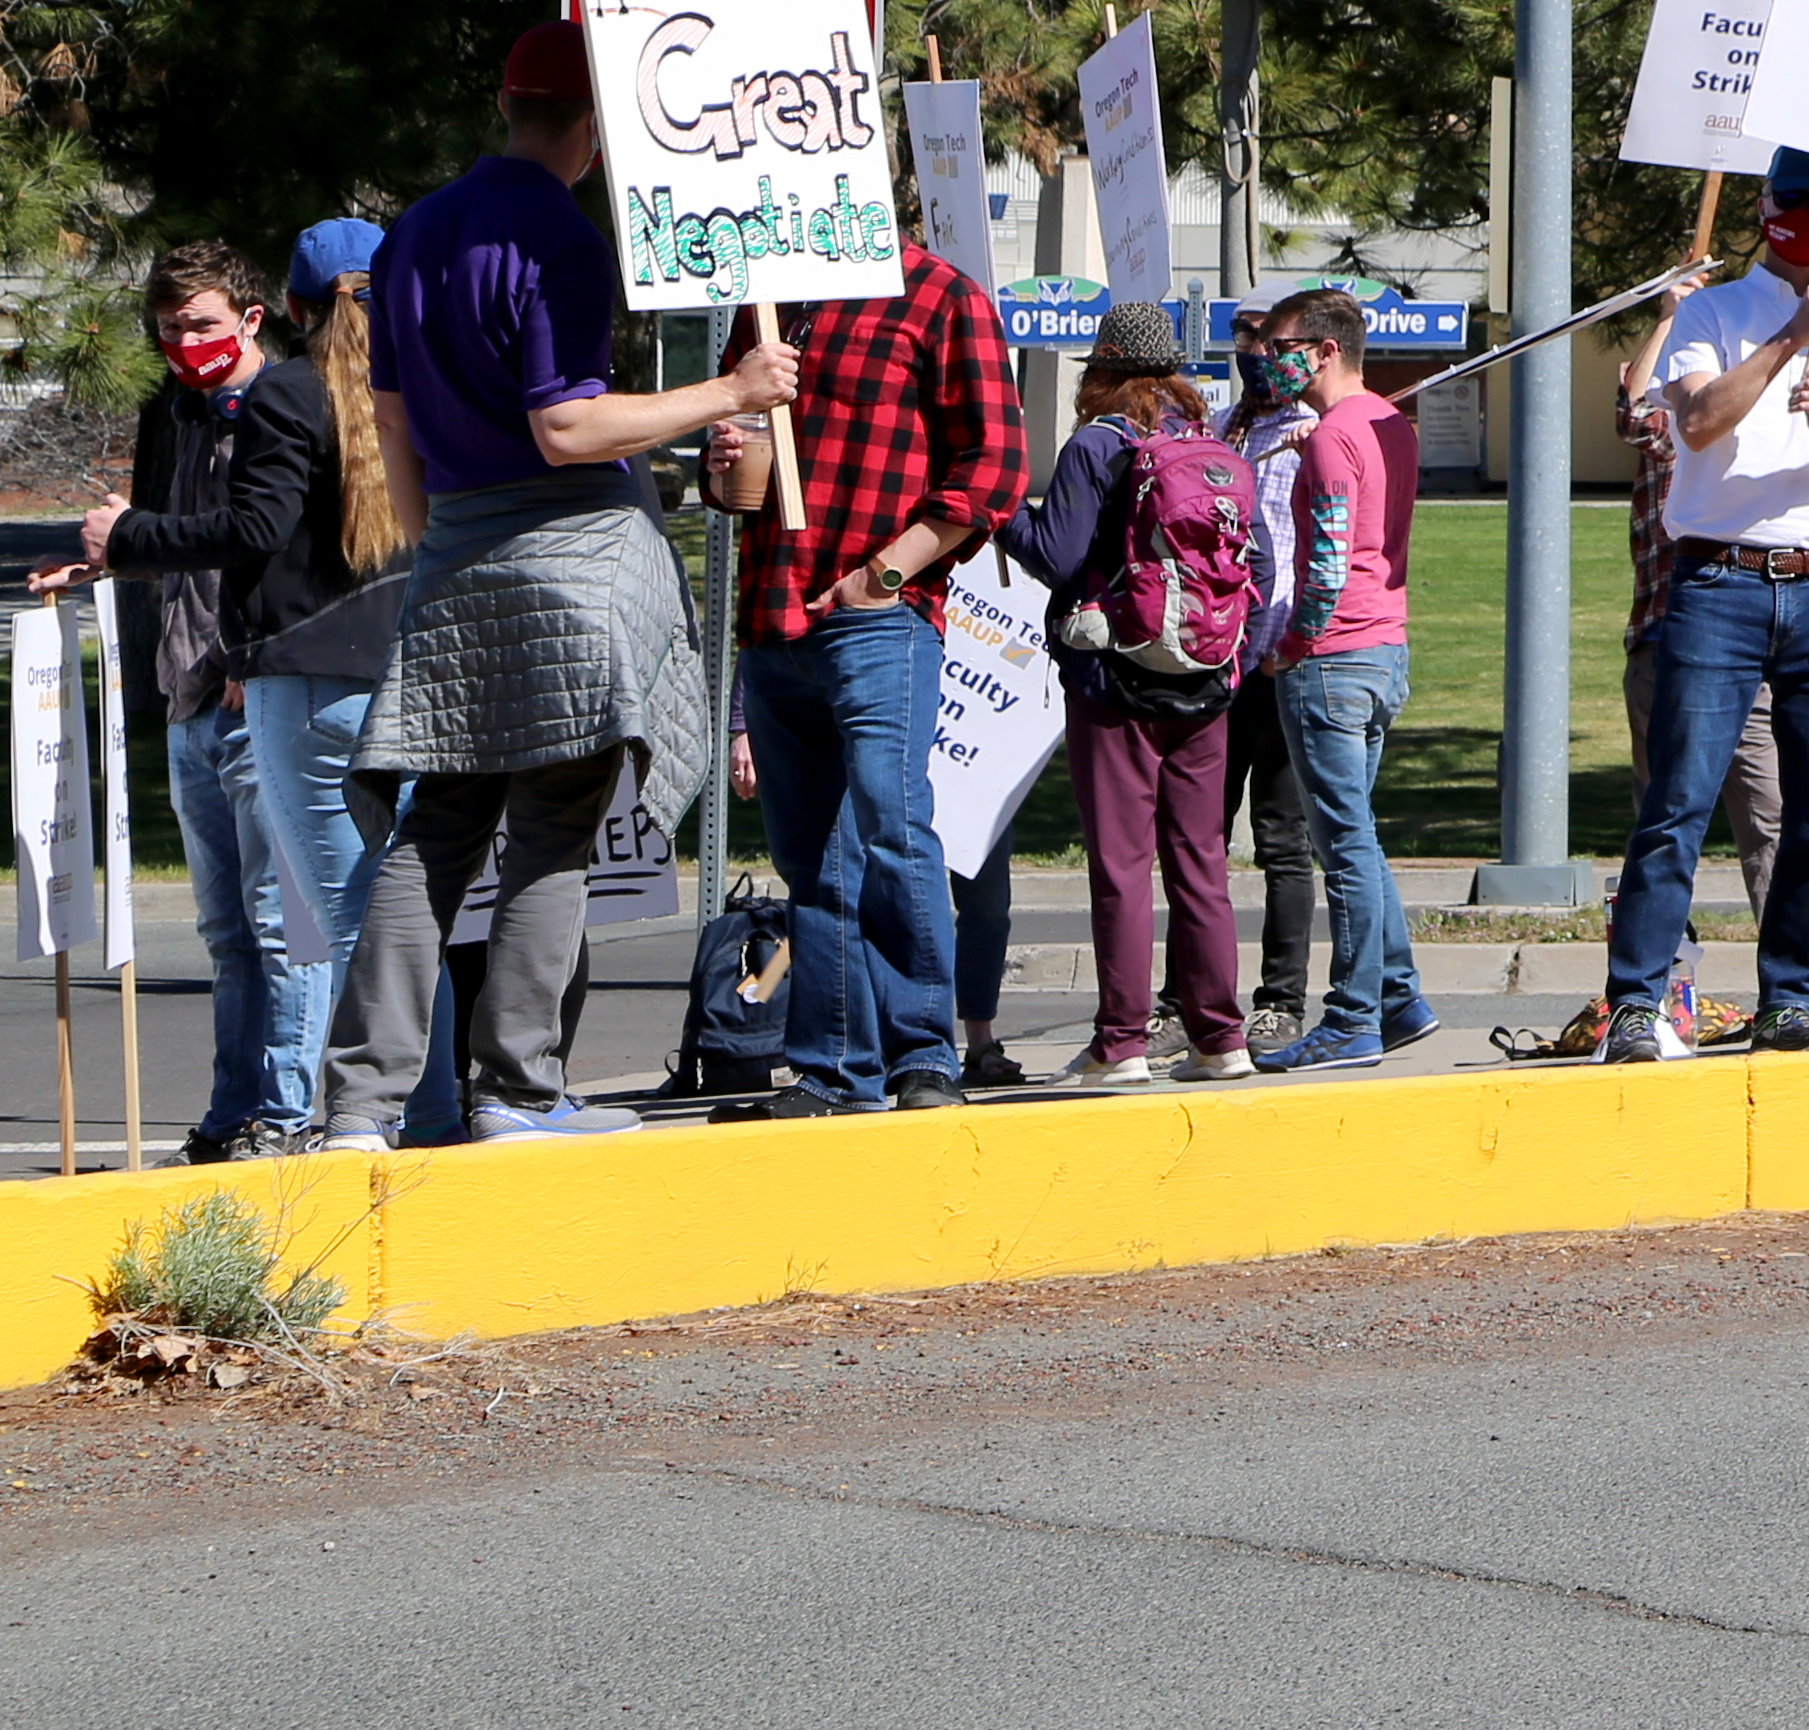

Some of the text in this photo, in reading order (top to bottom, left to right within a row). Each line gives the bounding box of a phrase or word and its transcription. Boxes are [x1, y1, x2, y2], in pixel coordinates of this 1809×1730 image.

[1700, 12, 1763, 37] Facu
[1727, 49, 1759, 67] on
[637, 11, 875, 162] Great
[1095, 68, 1139, 118] Oregon Tech
[945, 133, 967, 151] Tech
[627, 173, 894, 305] Negotiate
[1361, 308, 1427, 334] Drive
[943, 606, 1004, 647] AAUP
[54, 780, 68, 804] on
